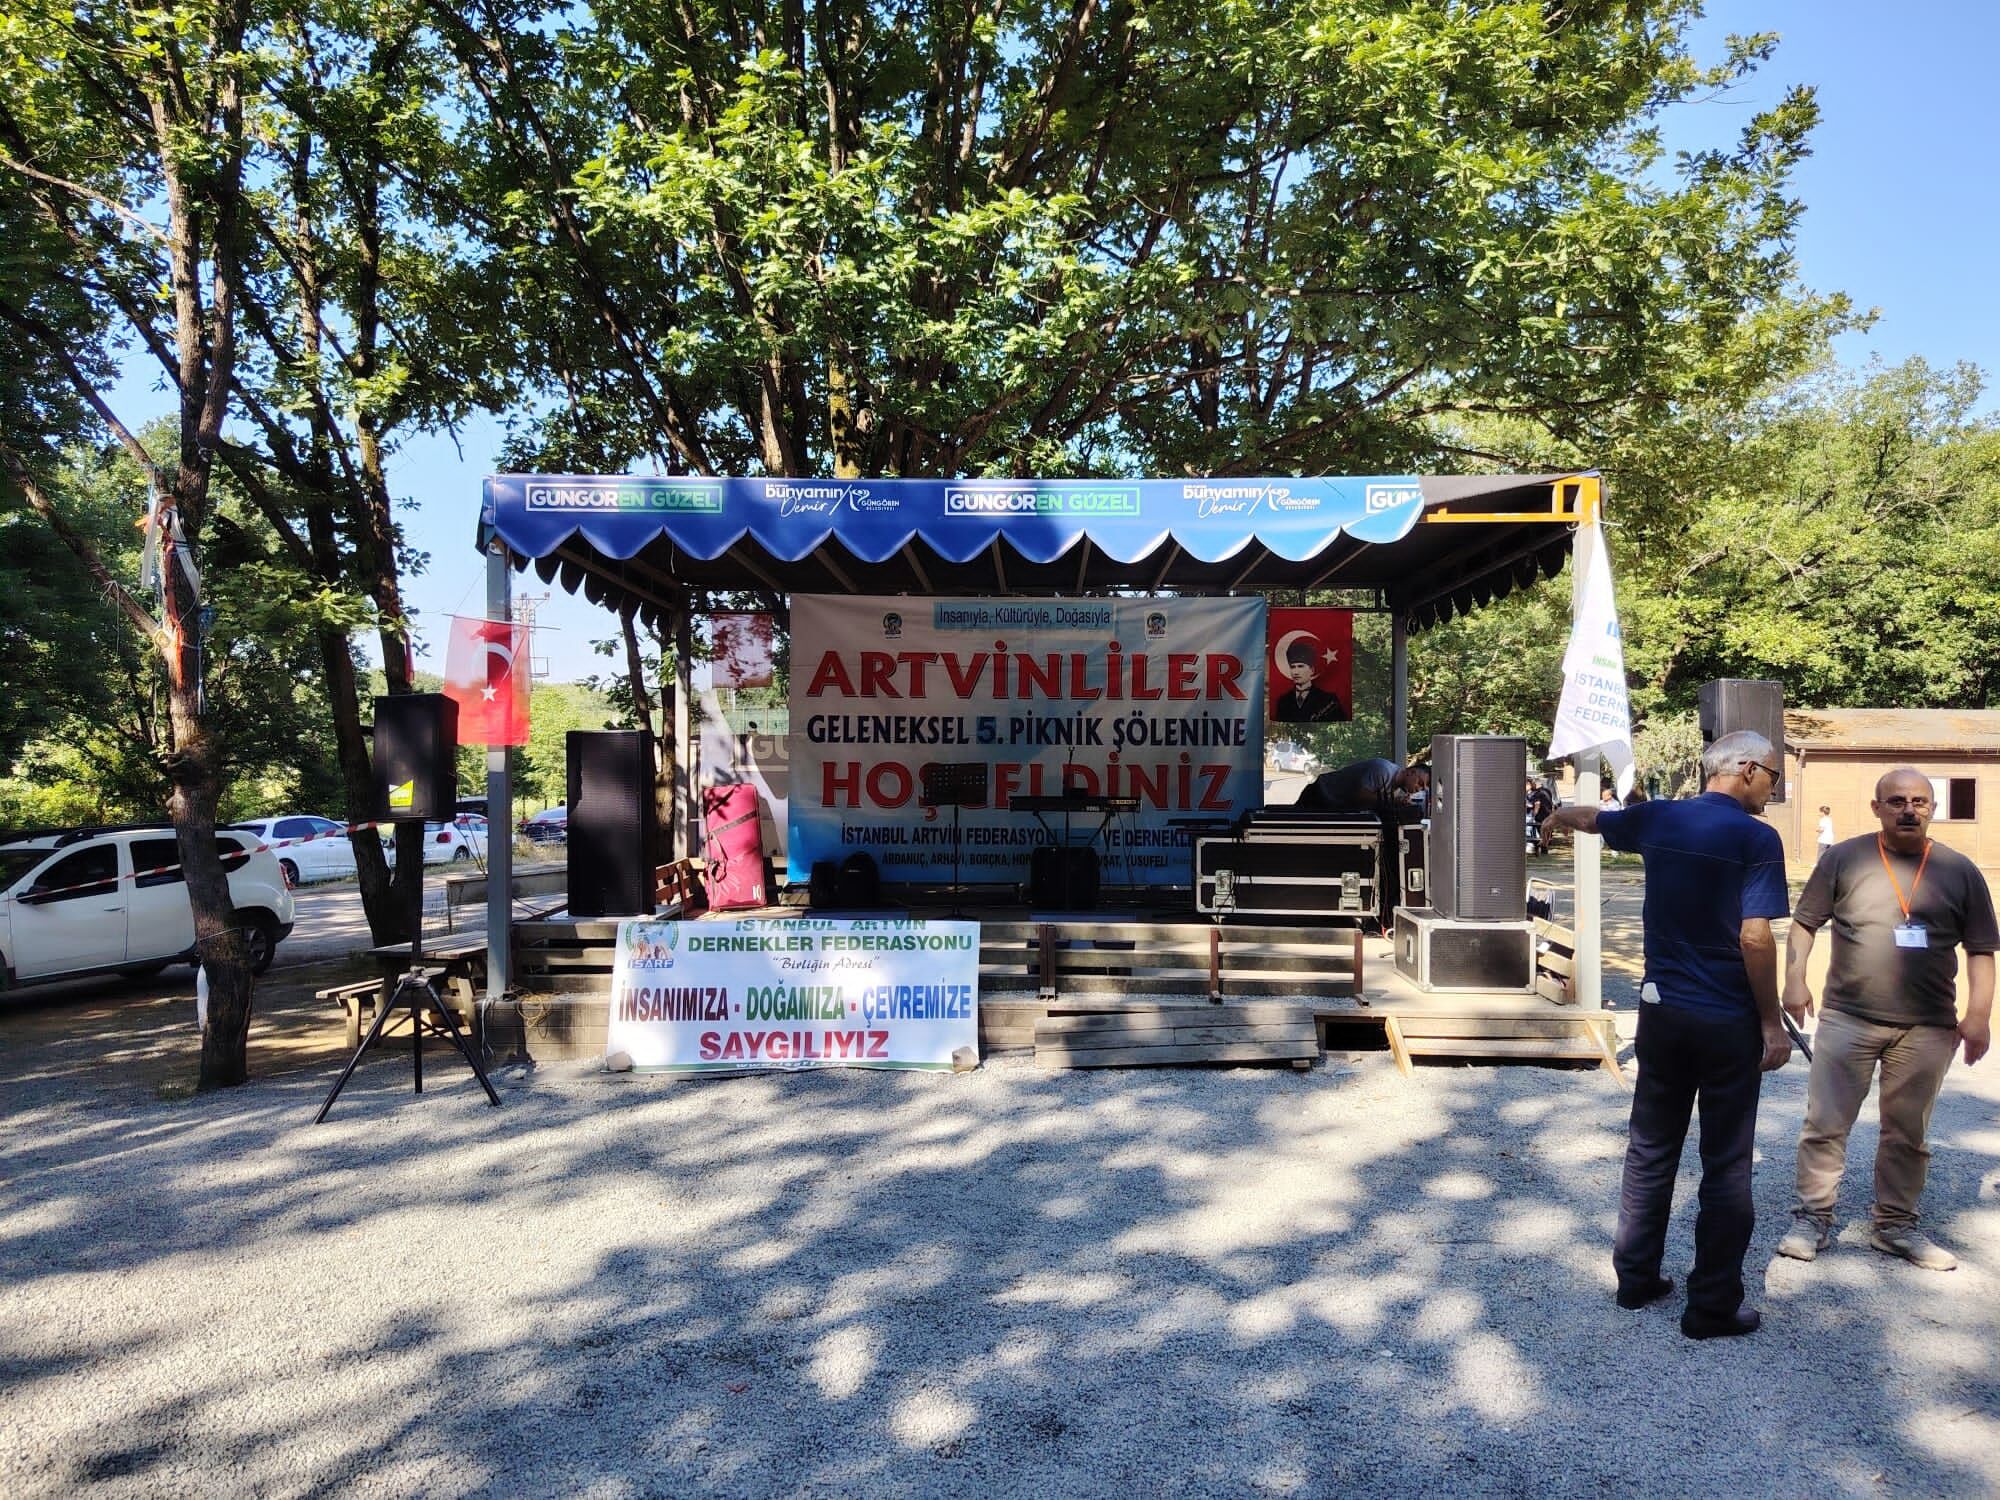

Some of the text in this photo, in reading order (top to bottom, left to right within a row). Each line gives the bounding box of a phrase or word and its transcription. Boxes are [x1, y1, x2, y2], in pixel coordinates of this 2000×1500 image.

[806, 640, 1249, 701] ARTVİNLİLER
[806, 714, 970, 745] GELENEKSEL
[1009, 709, 1103, 747] PİKNİK
[1112, 709, 1246, 753] ŞÖLENİNE
[842, 823, 907, 845] İSTANBUL
[912, 823, 962, 845] ARTVİN
[688, 934, 973, 952] DERNEKLER FEDERASYONU
[619, 977, 971, 1028] İNSANIMIZA DOĞAMIZA ÇEVREMİZE
[699, 1030, 890, 1060] SAYGILIYIZ
